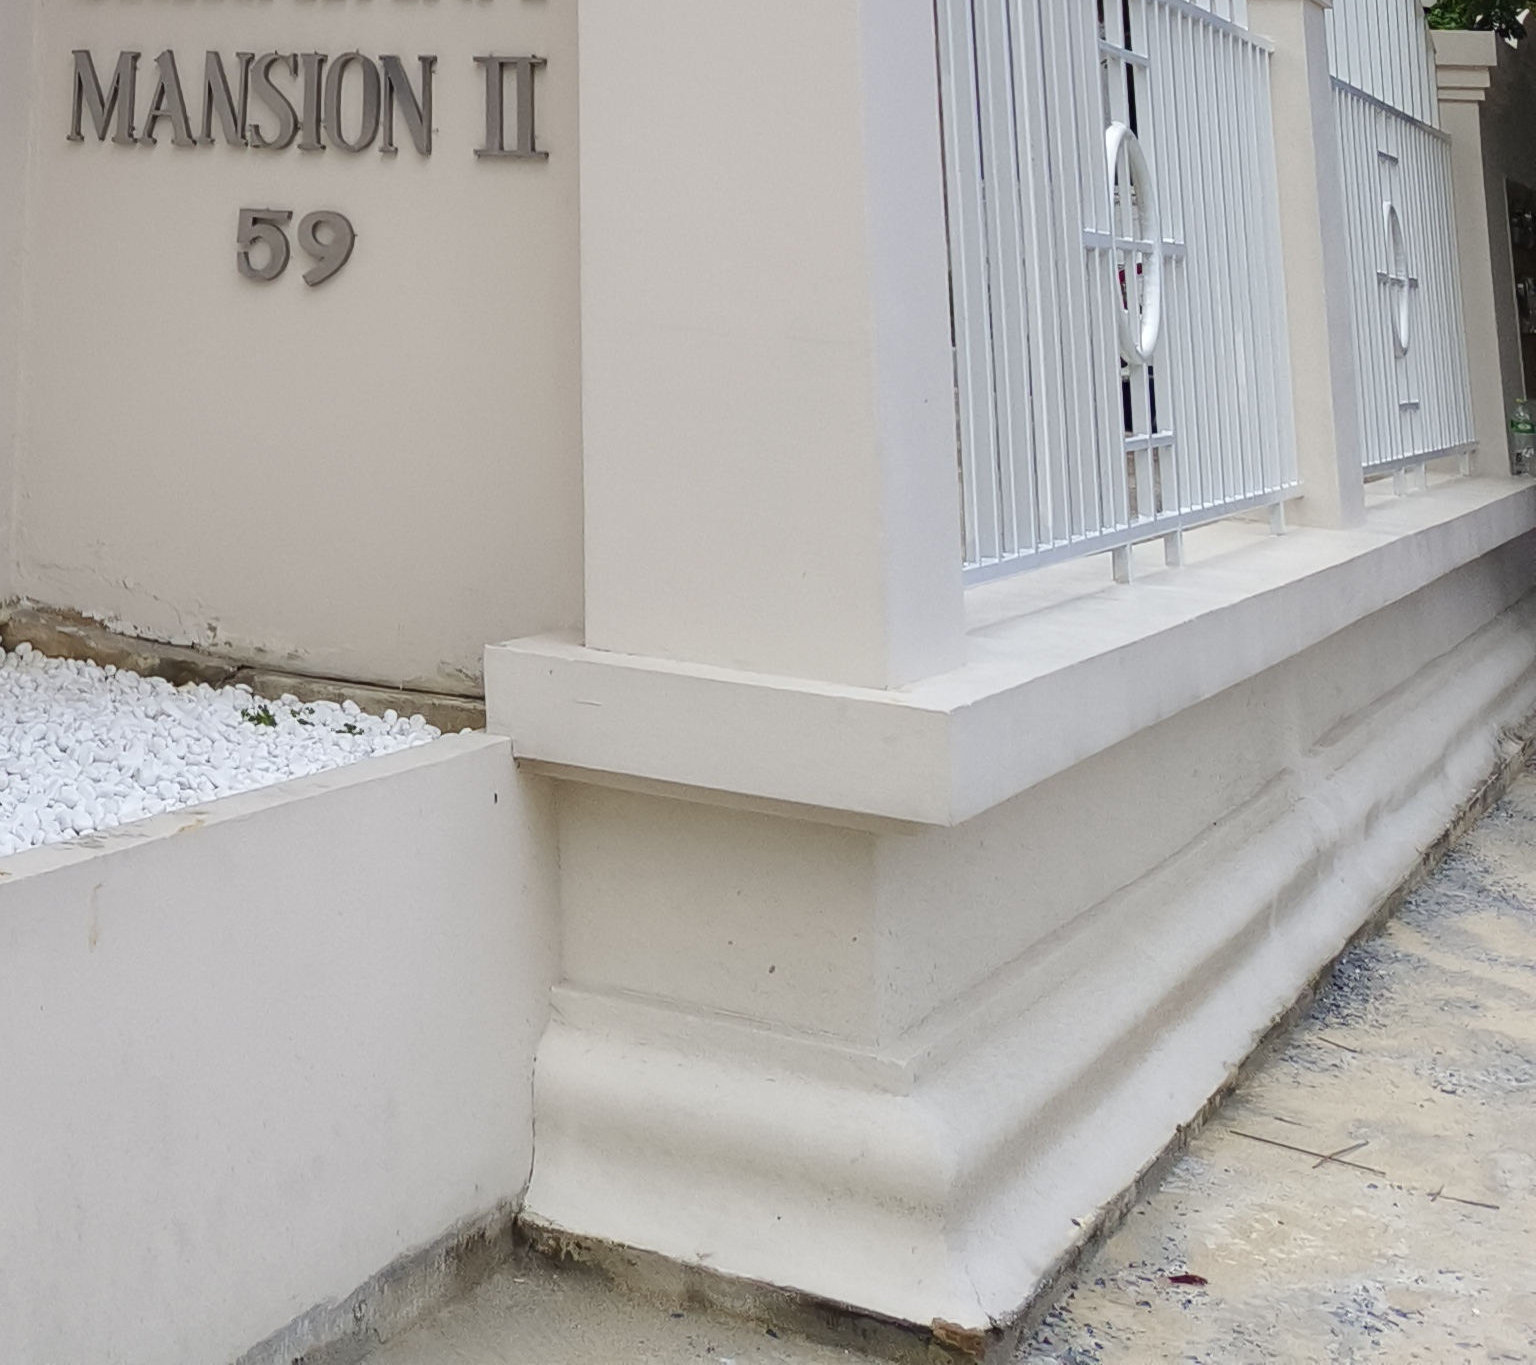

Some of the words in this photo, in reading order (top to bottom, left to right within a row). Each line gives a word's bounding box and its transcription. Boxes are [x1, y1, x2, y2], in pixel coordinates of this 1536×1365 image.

[67, 49, 438, 156] MANSION
[473, 52, 549, 159] II
[236, 207, 358, 287] 59
